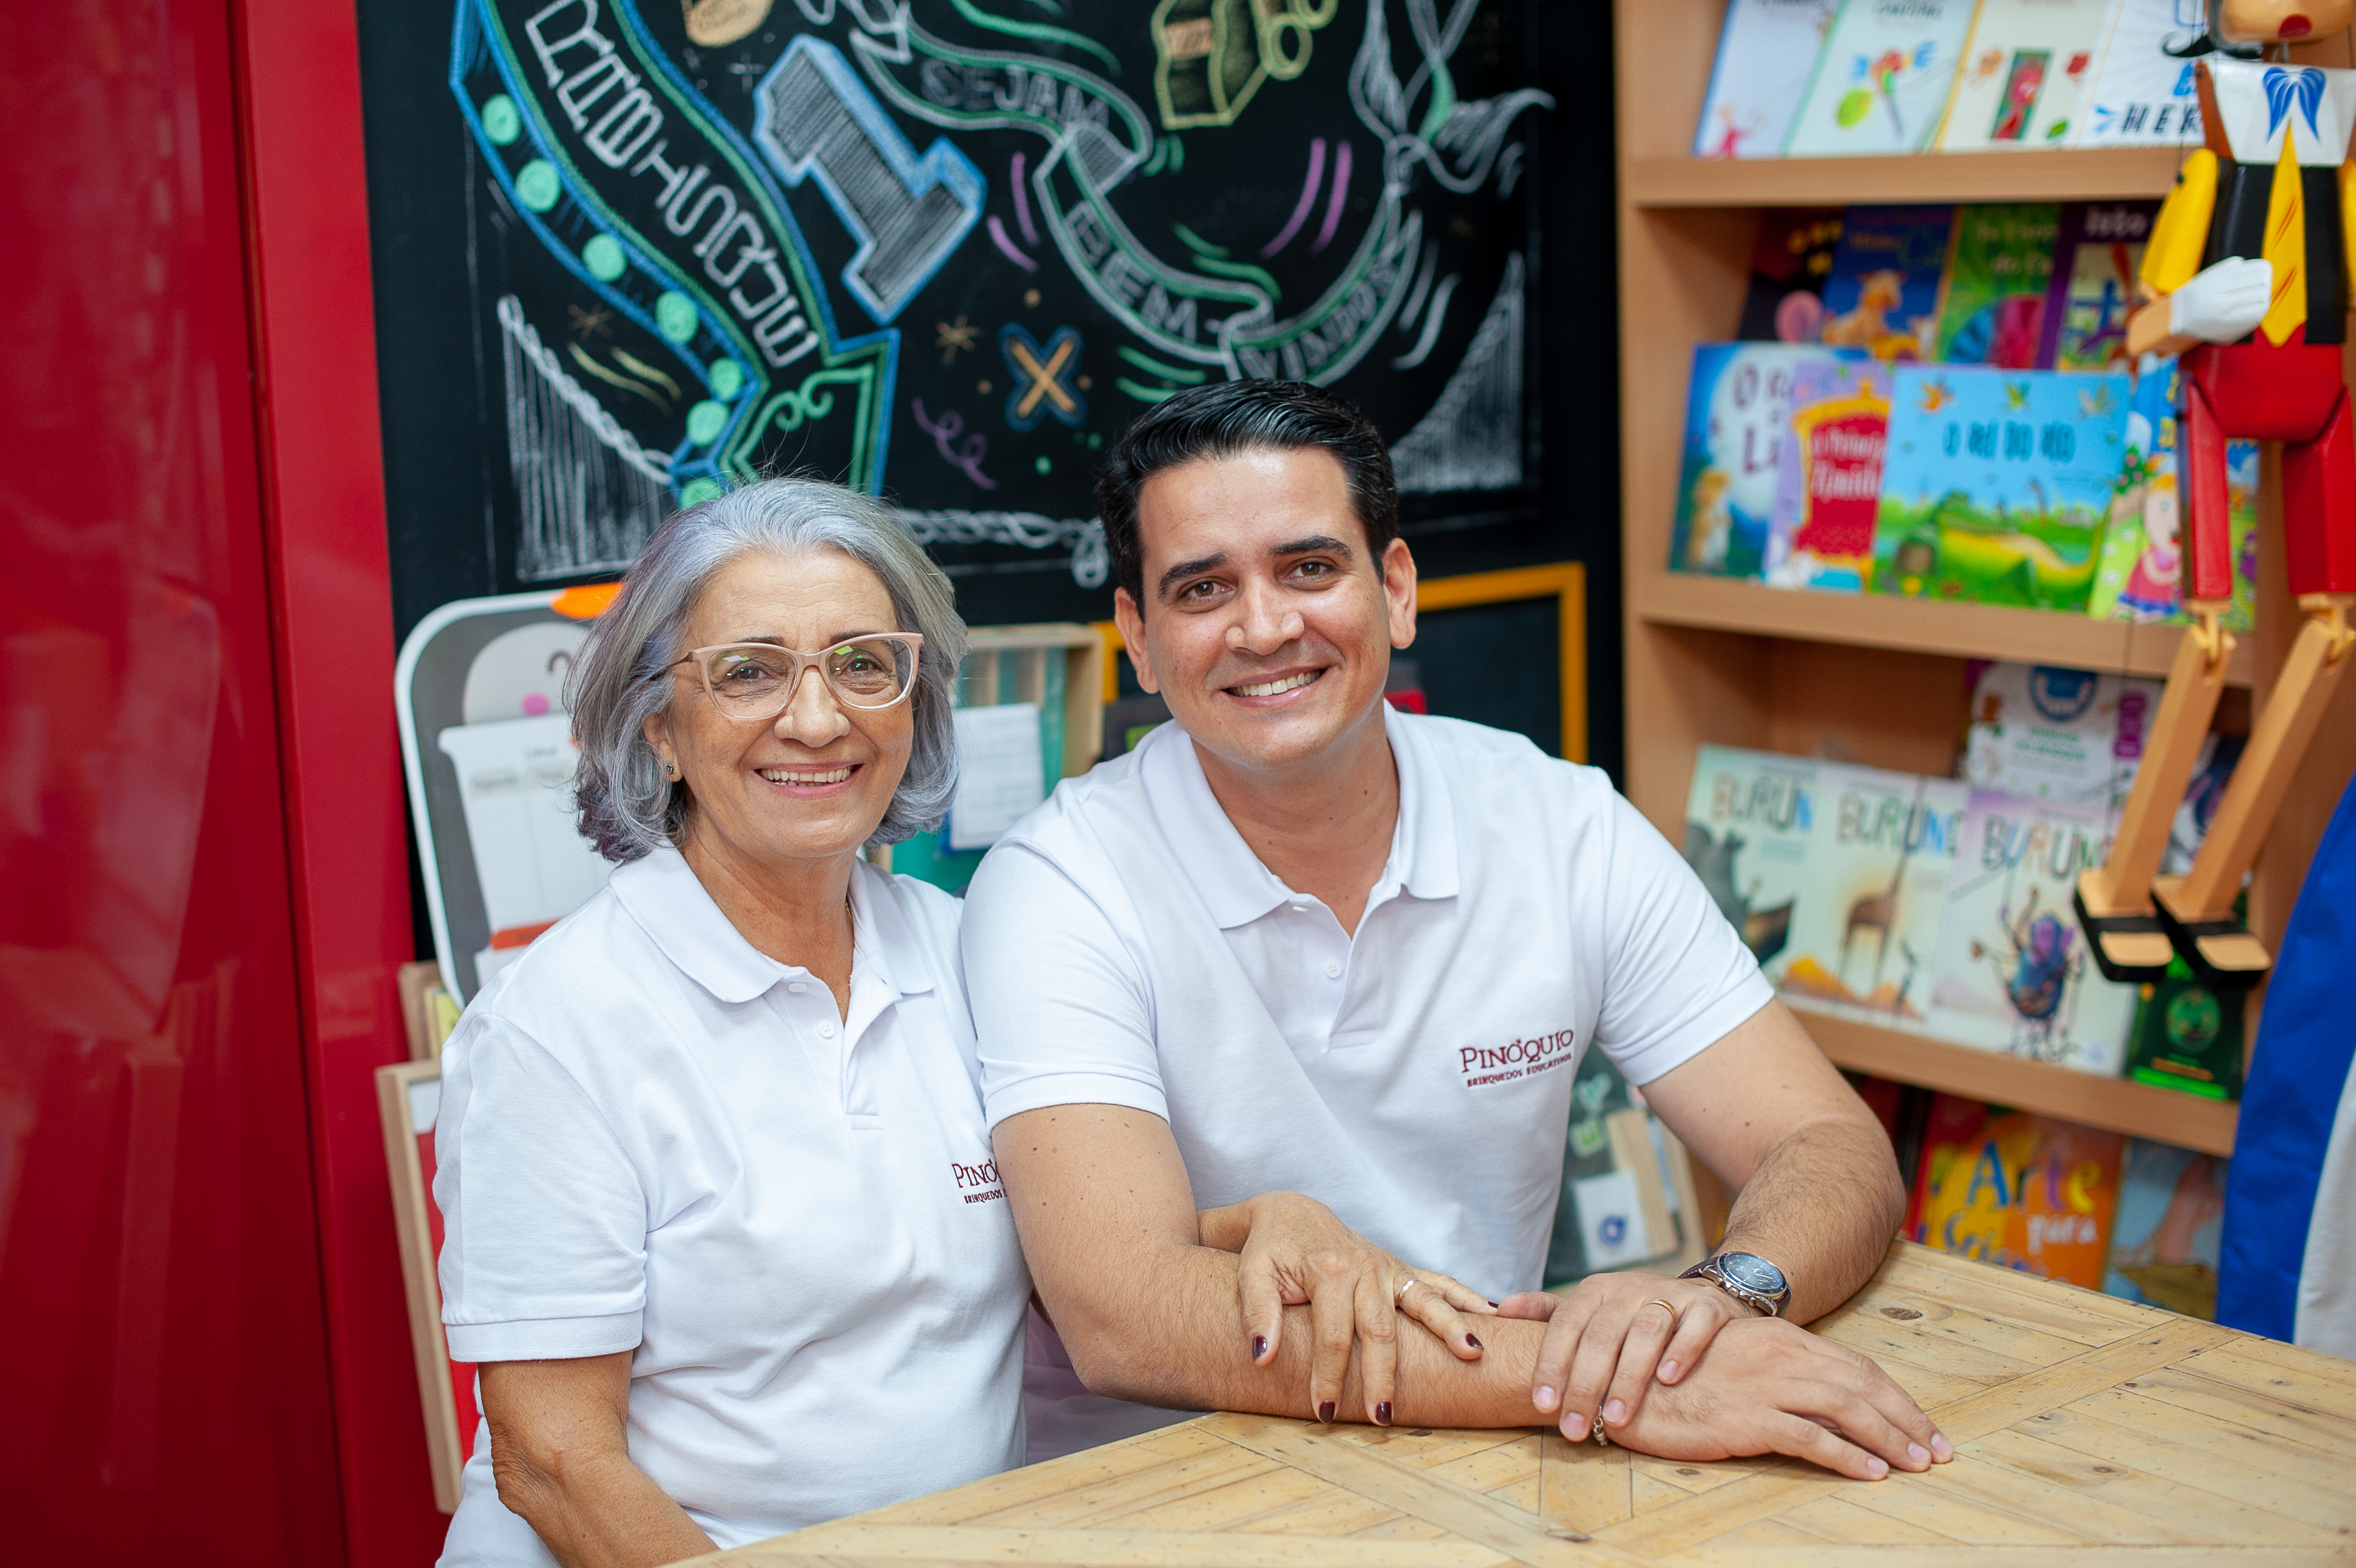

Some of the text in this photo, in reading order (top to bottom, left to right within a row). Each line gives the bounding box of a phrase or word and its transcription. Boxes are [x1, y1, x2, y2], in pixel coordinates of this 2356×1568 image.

[919, 57, 1109, 128] SEJAM
[1467, 1052, 1572, 1087] BRINQUEDOS EDUCATIVOS
[964, 1189, 1003, 1204] BRINQUEDOS
